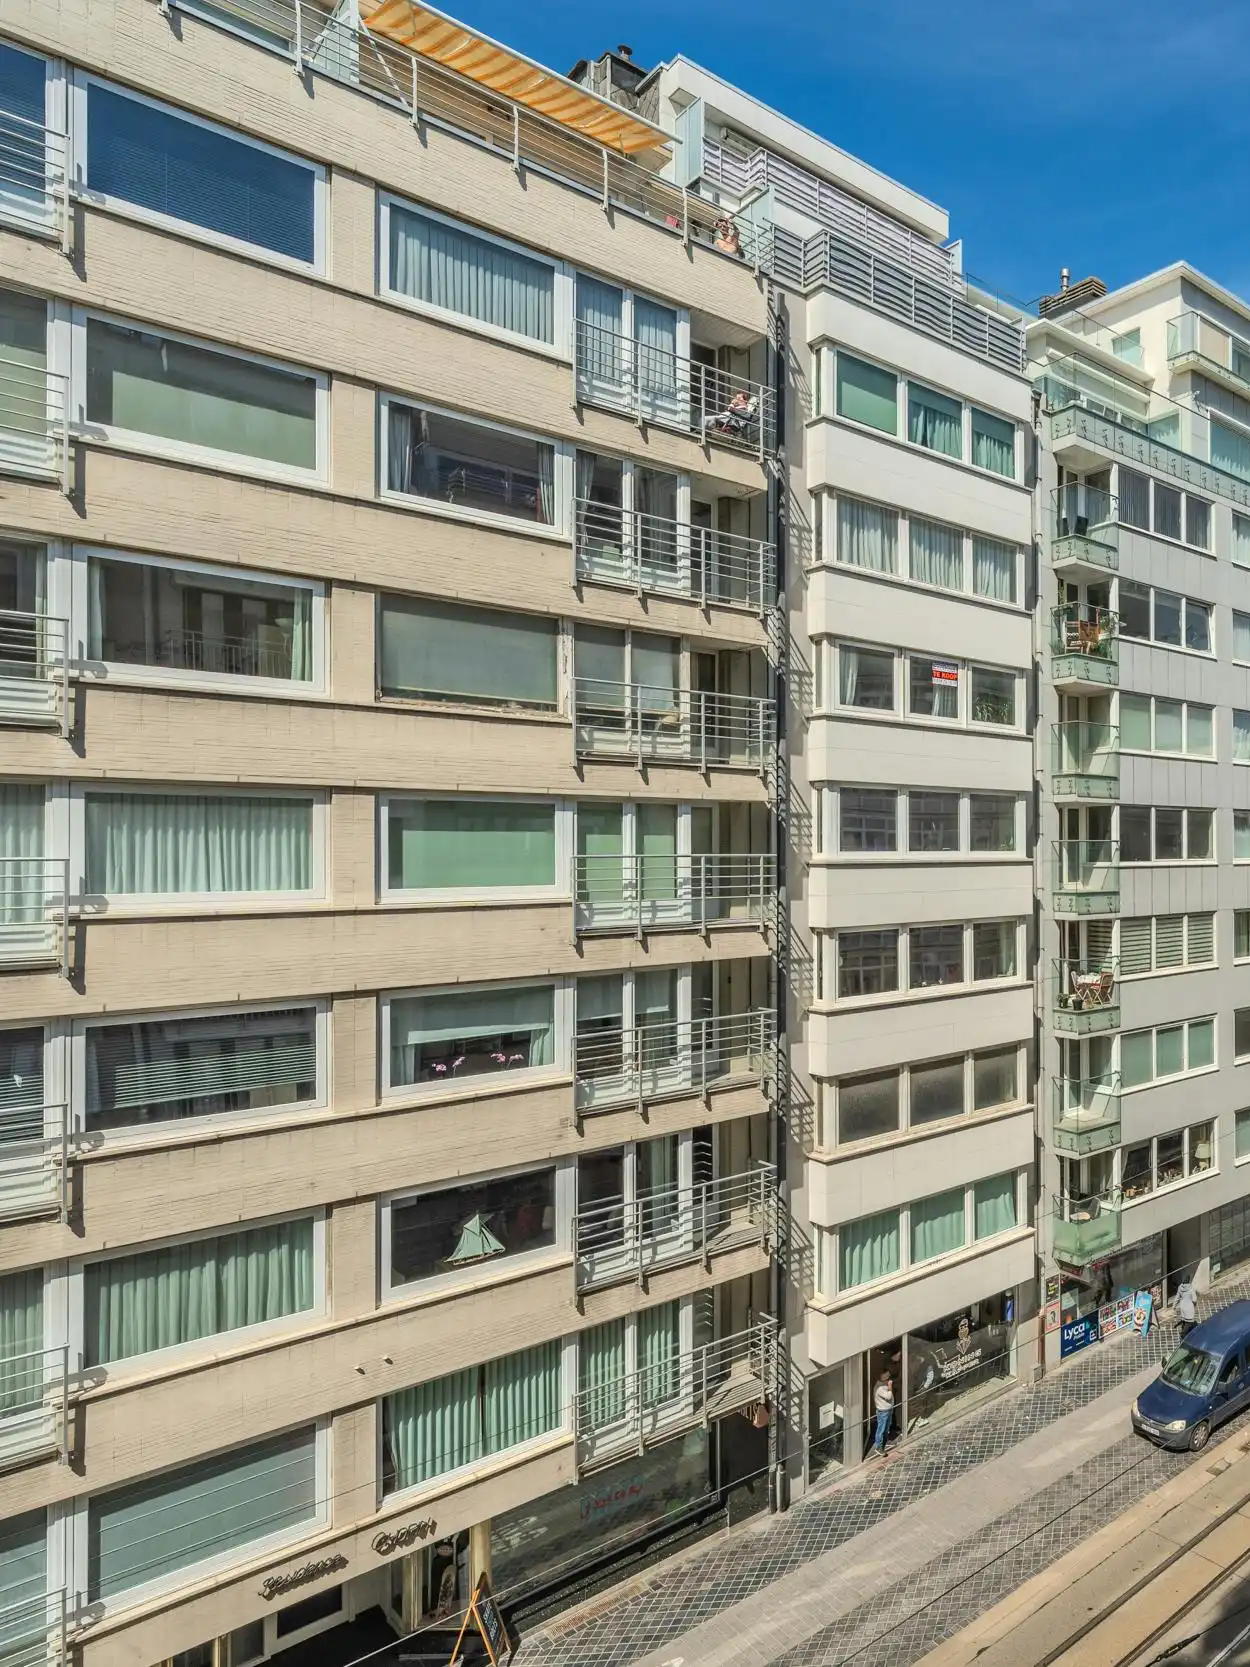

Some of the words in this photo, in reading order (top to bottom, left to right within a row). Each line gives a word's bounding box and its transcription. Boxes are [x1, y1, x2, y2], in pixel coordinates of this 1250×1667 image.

[932, 670, 941, 678] TE
[941, 672, 957, 680] KOOP
[1064, 1322, 1085, 1340] Lyca
